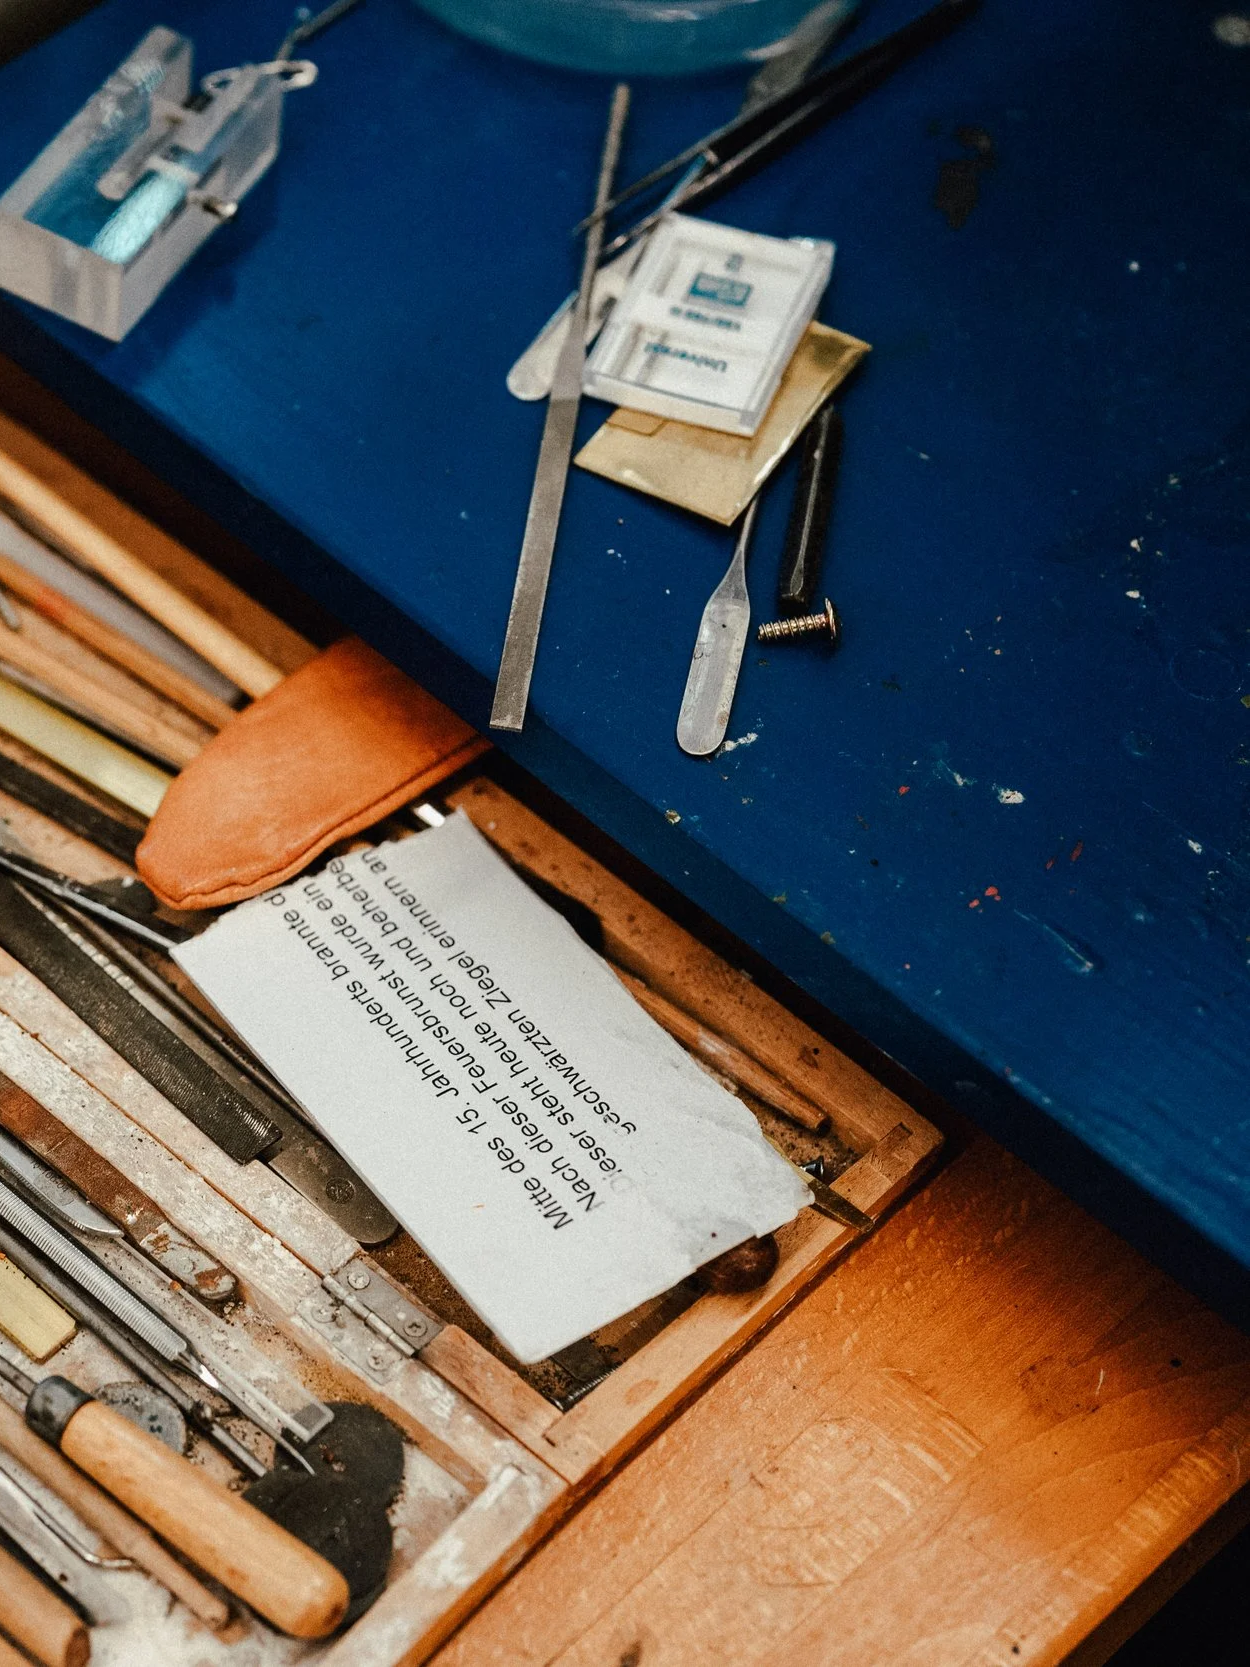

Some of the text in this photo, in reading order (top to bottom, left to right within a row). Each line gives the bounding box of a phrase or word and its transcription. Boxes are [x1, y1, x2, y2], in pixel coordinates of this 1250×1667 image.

[383, 875, 455, 948] erinnern
[282, 909, 350, 981] brannte
[389, 936, 432, 972] und
[429, 973, 478, 1019] noch
[446, 949, 512, 1010] Ziegel
[303, 882, 605, 1213] Nach dieser Feuersbrunst wurde ein
[346, 980, 459, 1097] Jahrhunderts
[473, 1021, 529, 1078] heute
[455, 1101, 487, 1134] 15.
[519, 1075, 574, 1126] steht
[487, 1136, 525, 1173] des
[523, 1176, 574, 1230] Mitte
